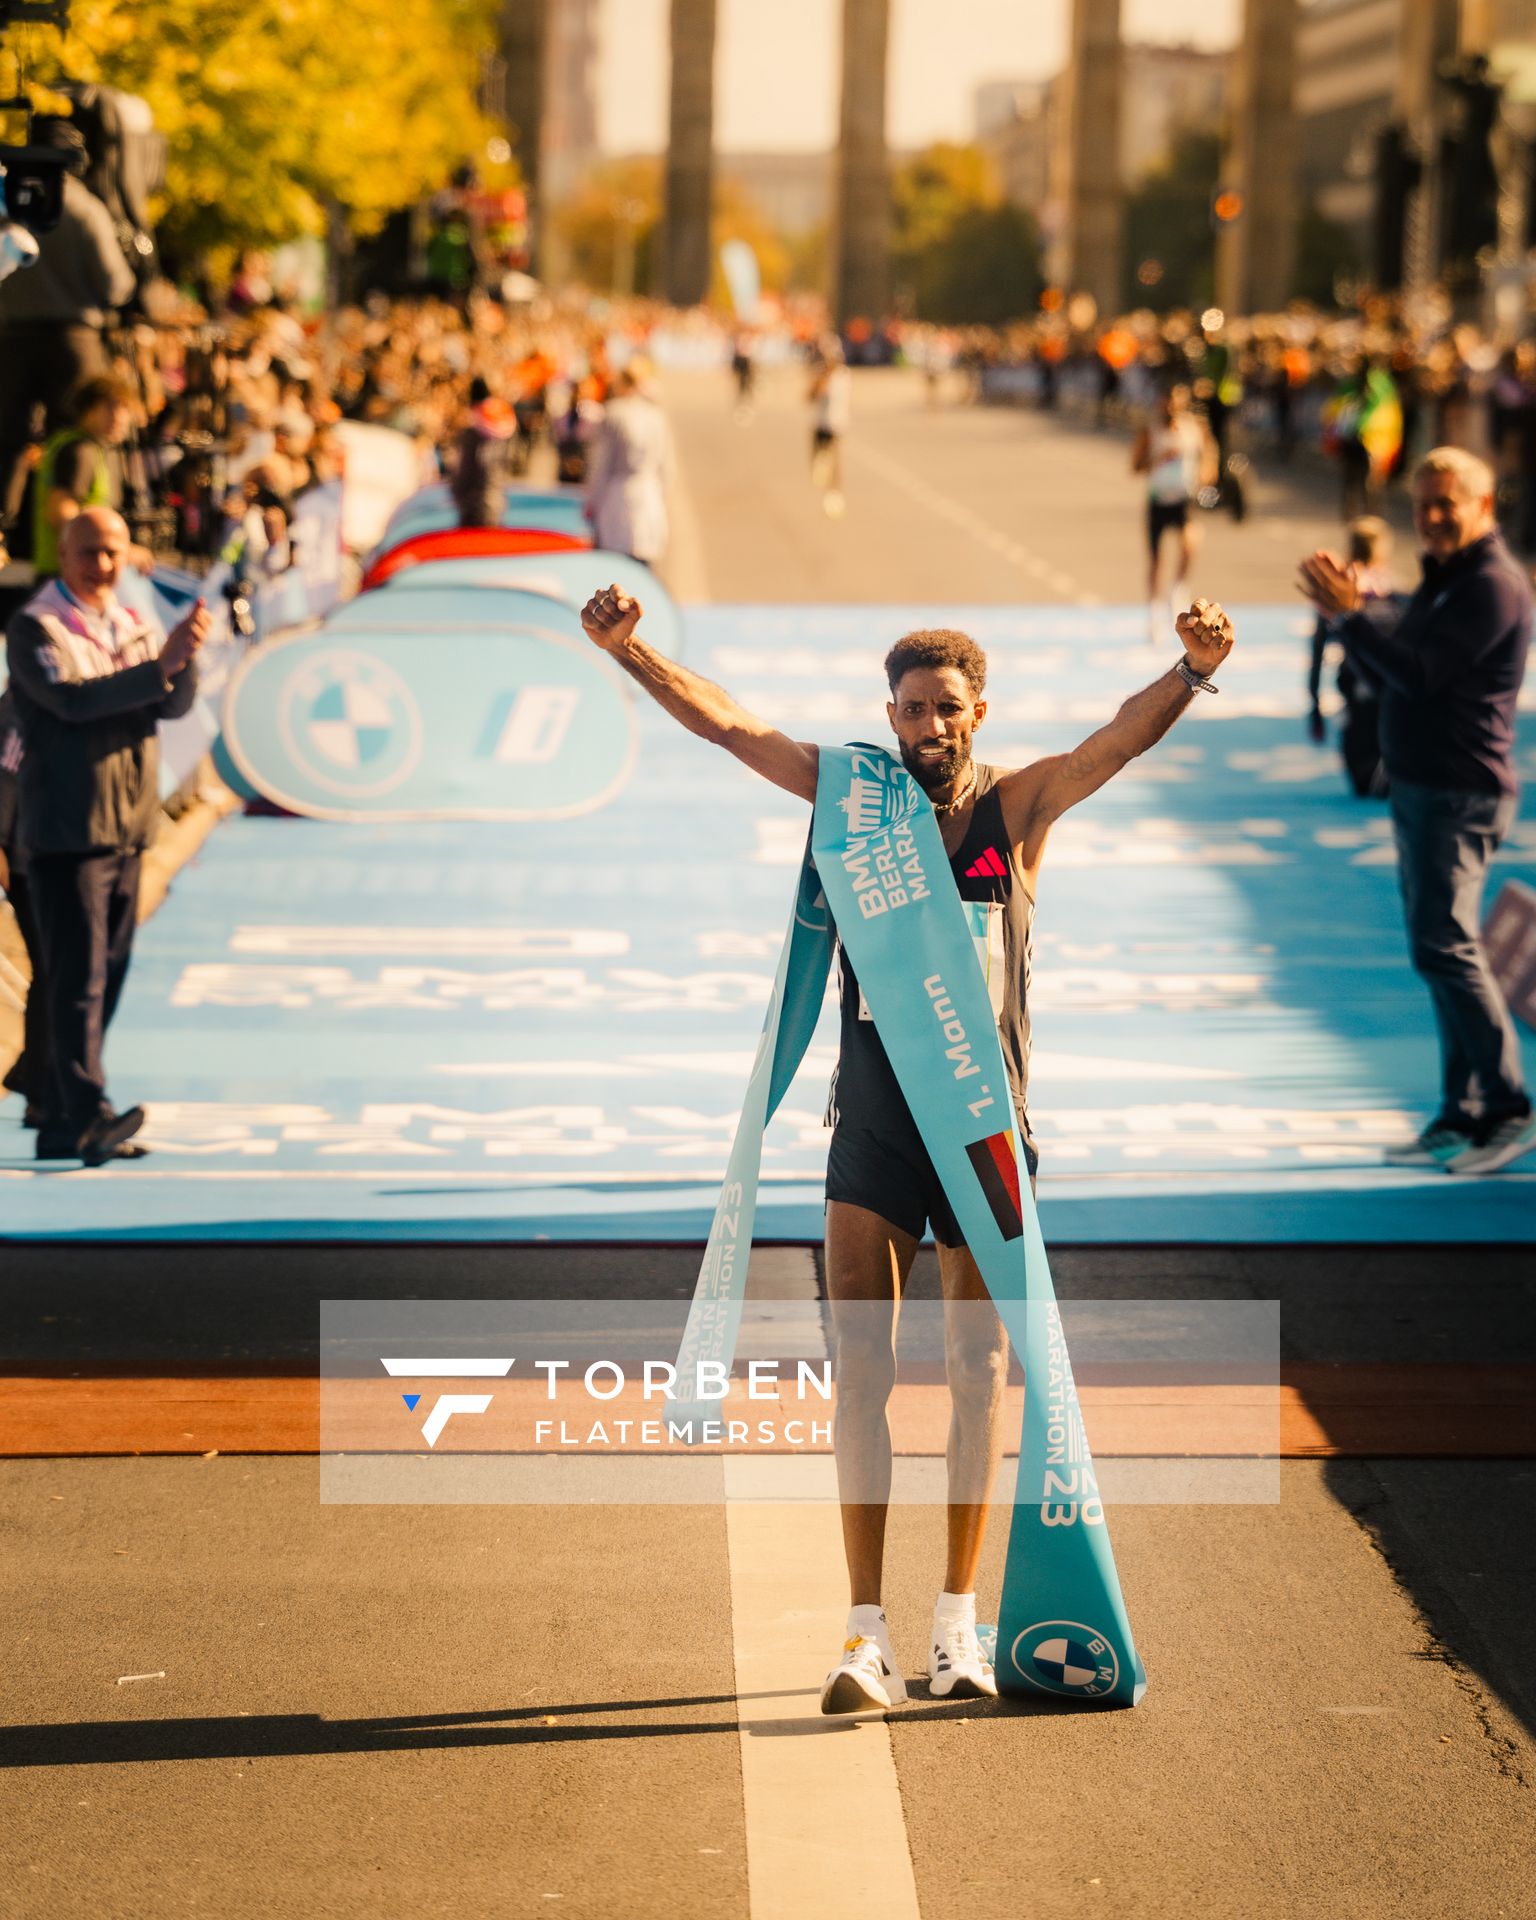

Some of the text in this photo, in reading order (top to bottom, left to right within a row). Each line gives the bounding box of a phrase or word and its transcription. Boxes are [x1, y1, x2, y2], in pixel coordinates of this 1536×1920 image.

[841, 834, 888, 920] BMW
[892, 774, 931, 901] MARAHON
[923, 973, 995, 1119] 1. Mann
[720, 1181, 743, 1240] 23
[1045, 1302, 1065, 1465] MARATHON
[1040, 1469, 1079, 1527] 23
[1084, 1638, 1112, 1694] BMW
